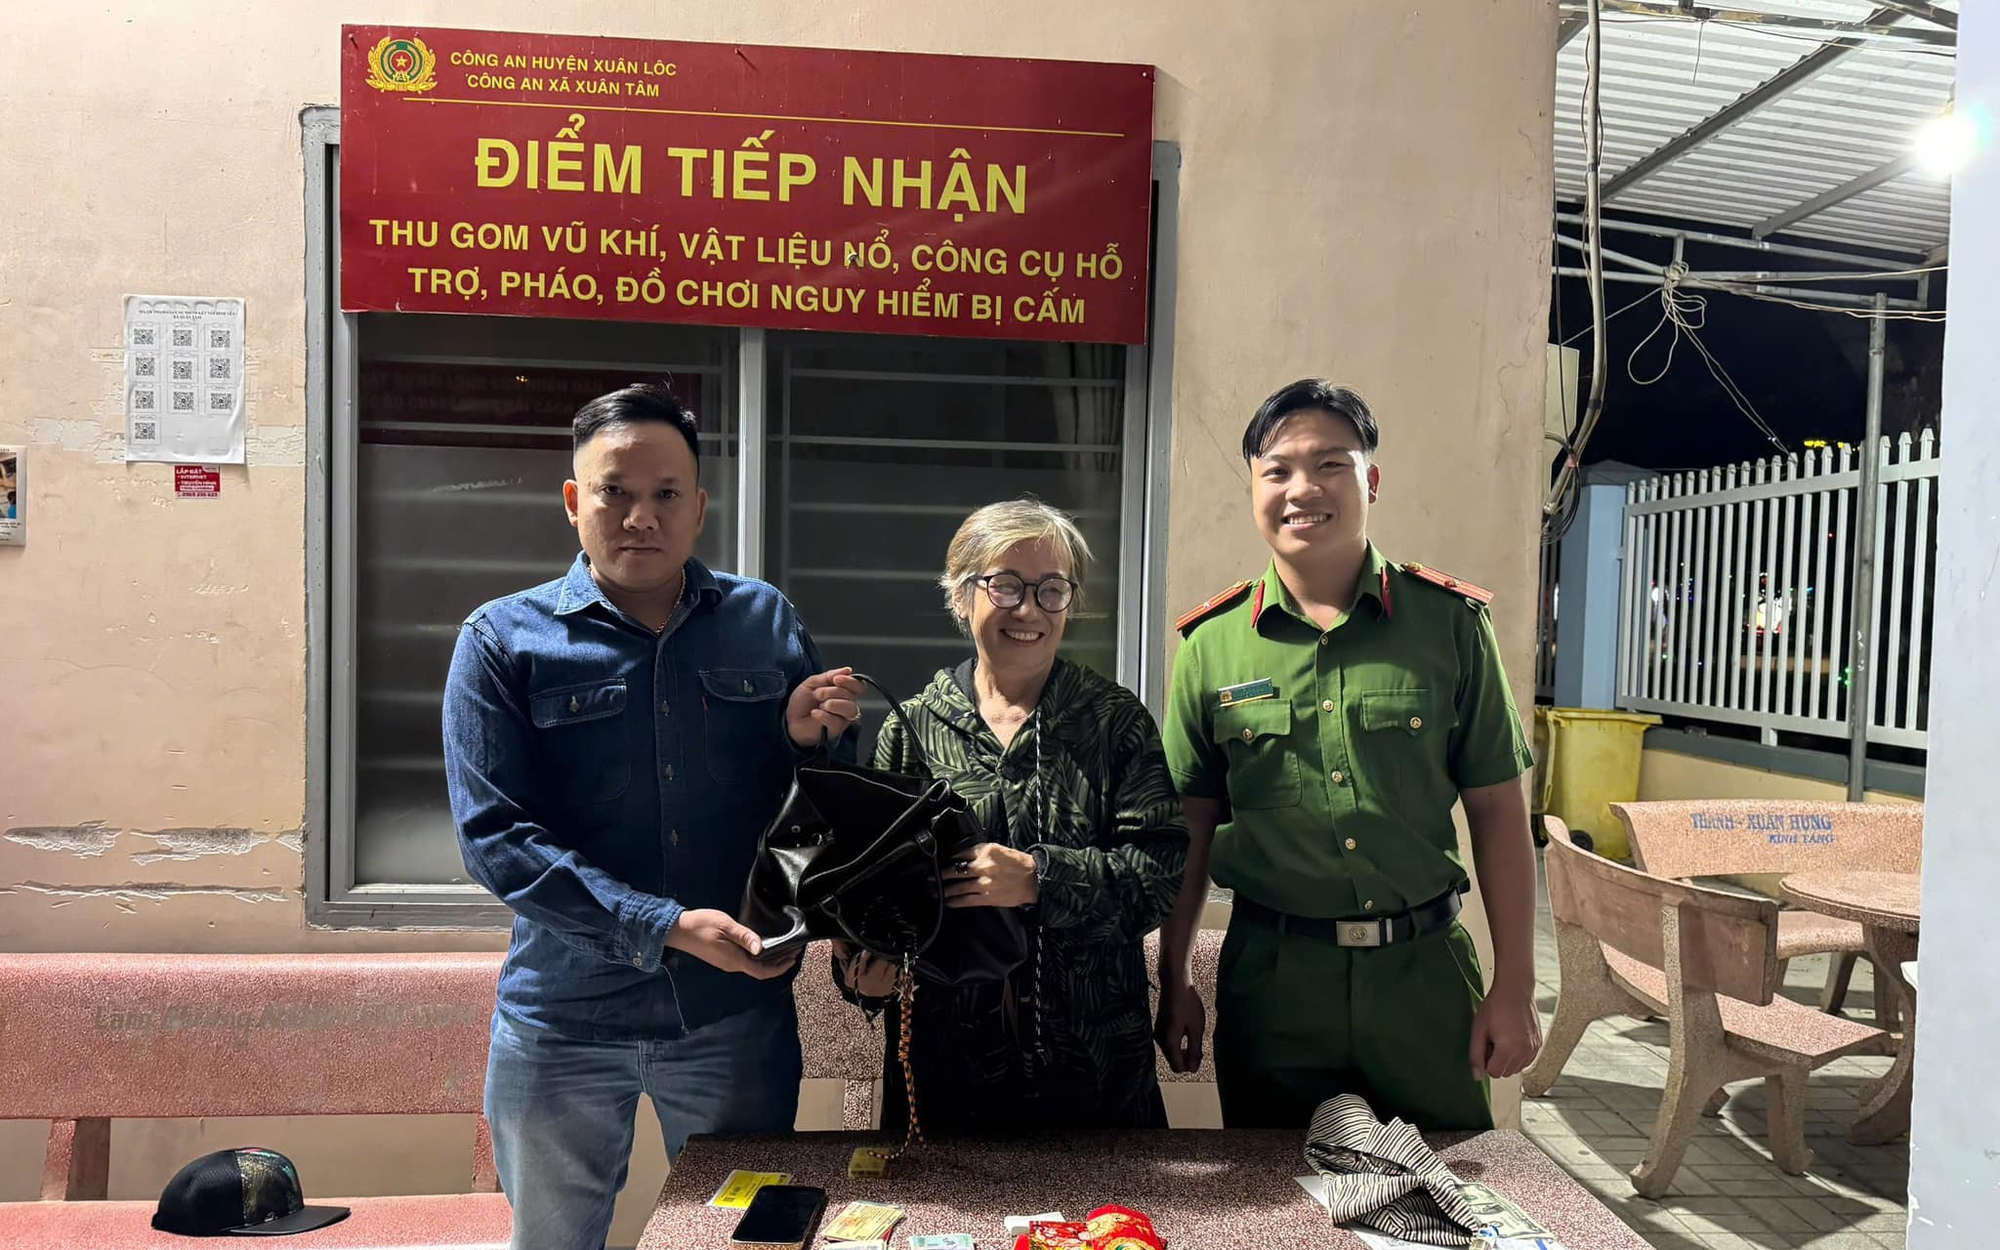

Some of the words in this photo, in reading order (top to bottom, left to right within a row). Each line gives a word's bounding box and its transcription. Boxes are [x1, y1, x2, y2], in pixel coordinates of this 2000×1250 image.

[450, 50, 499, 67] CÔNG
[503, 55, 527, 69] AN
[531, 55, 589, 73] HUYỆN
[593, 57, 638, 74] XUÂN
[467, 73, 516, 90] CÔNG
[520, 77, 544, 91] AN
[548, 76, 571, 93] XÃ
[575, 78, 620, 95] XUÂN
[625, 80, 660, 98] TÂM
[475, 113, 642, 195] ĐIỂM
[667, 129, 817, 202] TIẾP
[843, 148, 1026, 223] NHẬN
[369, 219, 438, 248] THU
[450, 221, 529, 251] GOM
[542, 221, 587, 254] VŨ
[600, 224, 667, 263] KHÍ,
[679, 228, 746, 266] VẬT
[757, 232, 832, 270] LIỆU
[844, 229, 899, 274] NỔ,
[912, 240, 1007, 275] CÔNG
[1020, 249, 1064, 282] CỤ
[1076, 242, 1123, 280] HỖ
[408, 267, 488, 300] TRỢ,
[500, 267, 604, 306] PHÁO,
[616, 268, 666, 304] ĐỒ
[676, 279, 759, 308] CHƠI
[771, 284, 865, 313] NGUY
[878, 278, 958, 318] HIỂM
[972, 294, 1002, 325] BỊ
[1013, 287, 1085, 324] CẤM
